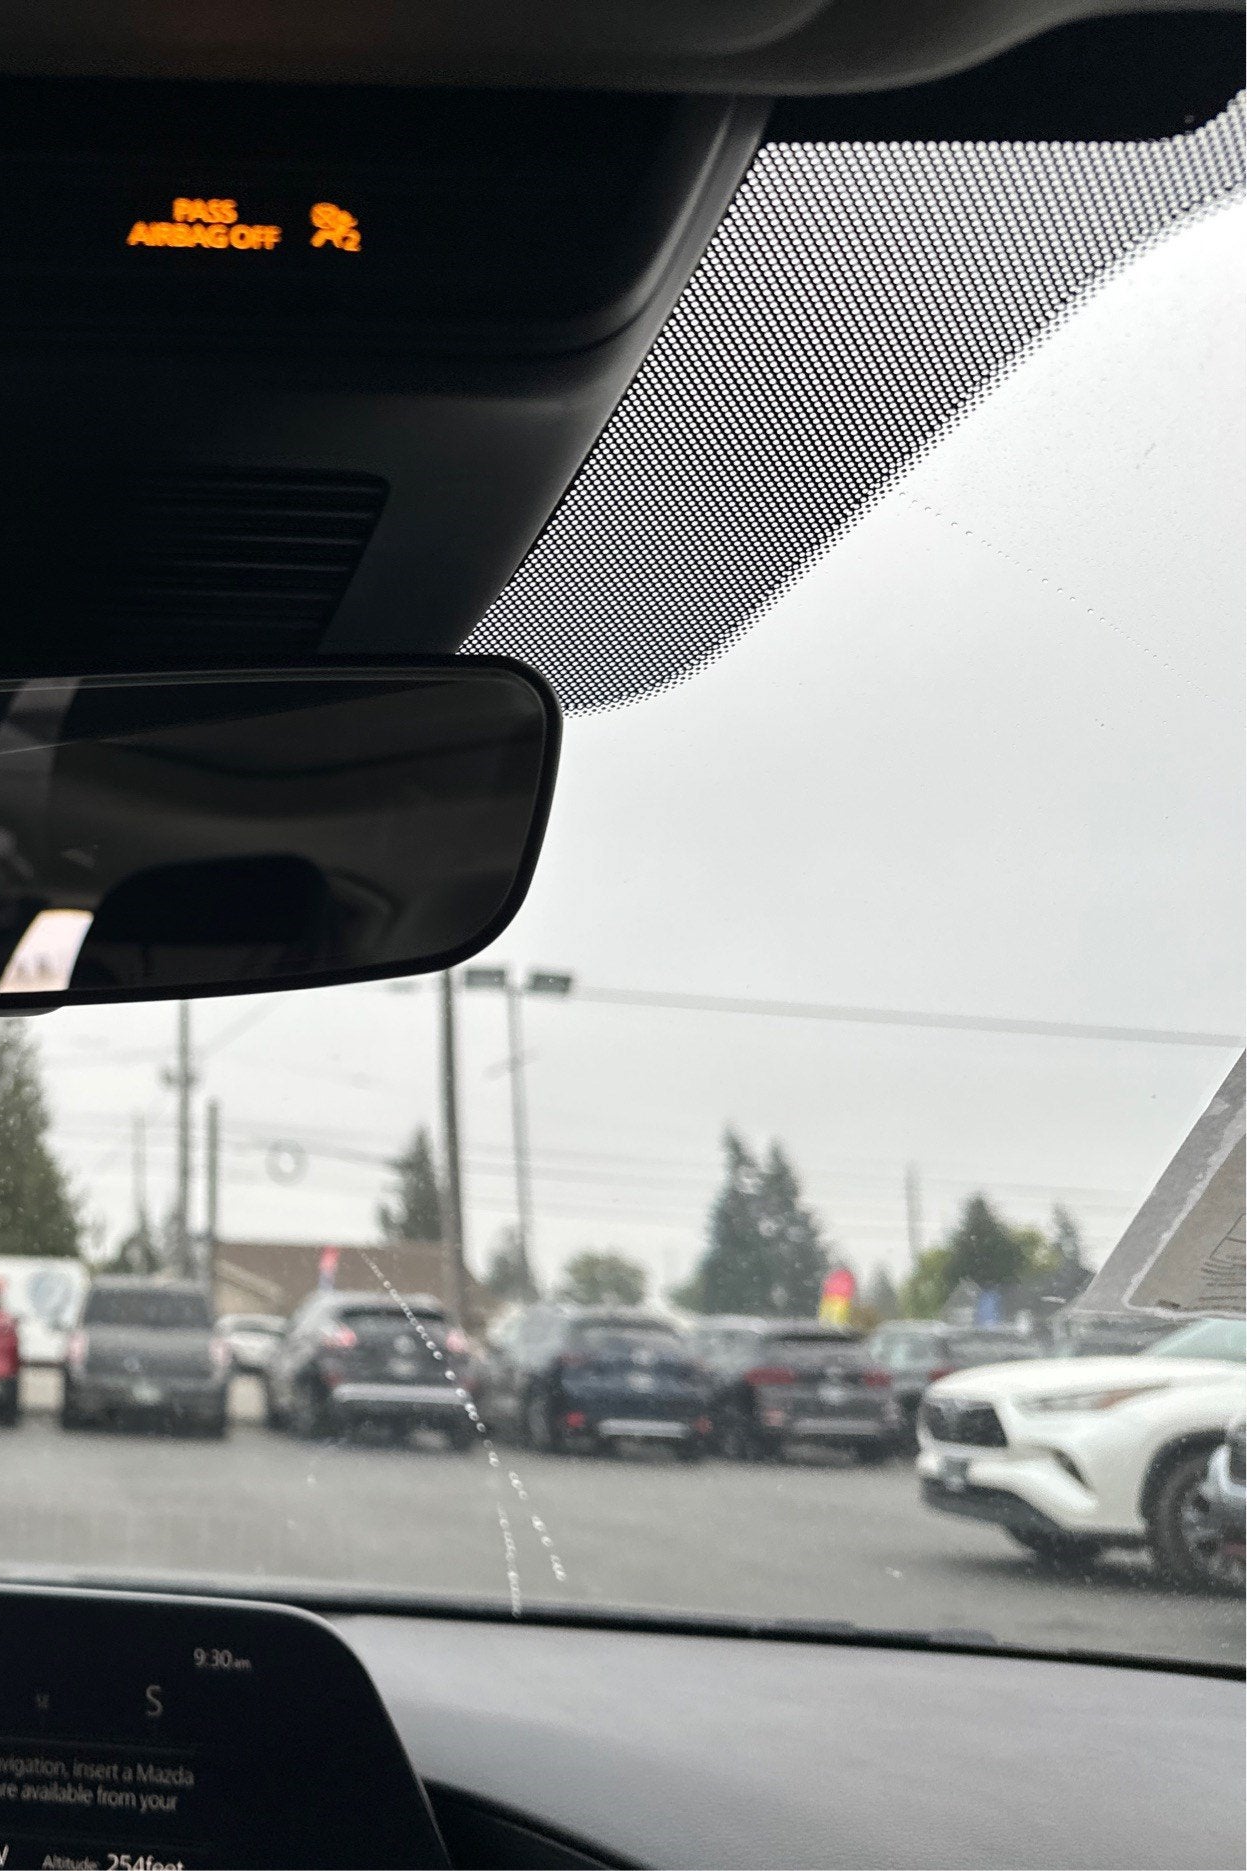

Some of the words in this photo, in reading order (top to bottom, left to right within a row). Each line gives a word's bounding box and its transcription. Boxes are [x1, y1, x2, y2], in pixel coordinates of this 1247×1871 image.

[172, 197, 238, 224] PASS
[126, 220, 229, 249] AIRBAG
[229, 224, 282, 250] OFF
[145, 1684, 163, 1717] S
[72, 1758, 119, 1782] insert
[122, 1766, 133, 1781] a
[136, 1762, 195, 1788] Mazda
[21, 1782, 94, 1807] available
[97, 1784, 137, 1810] from
[140, 1793, 178, 1814] your
